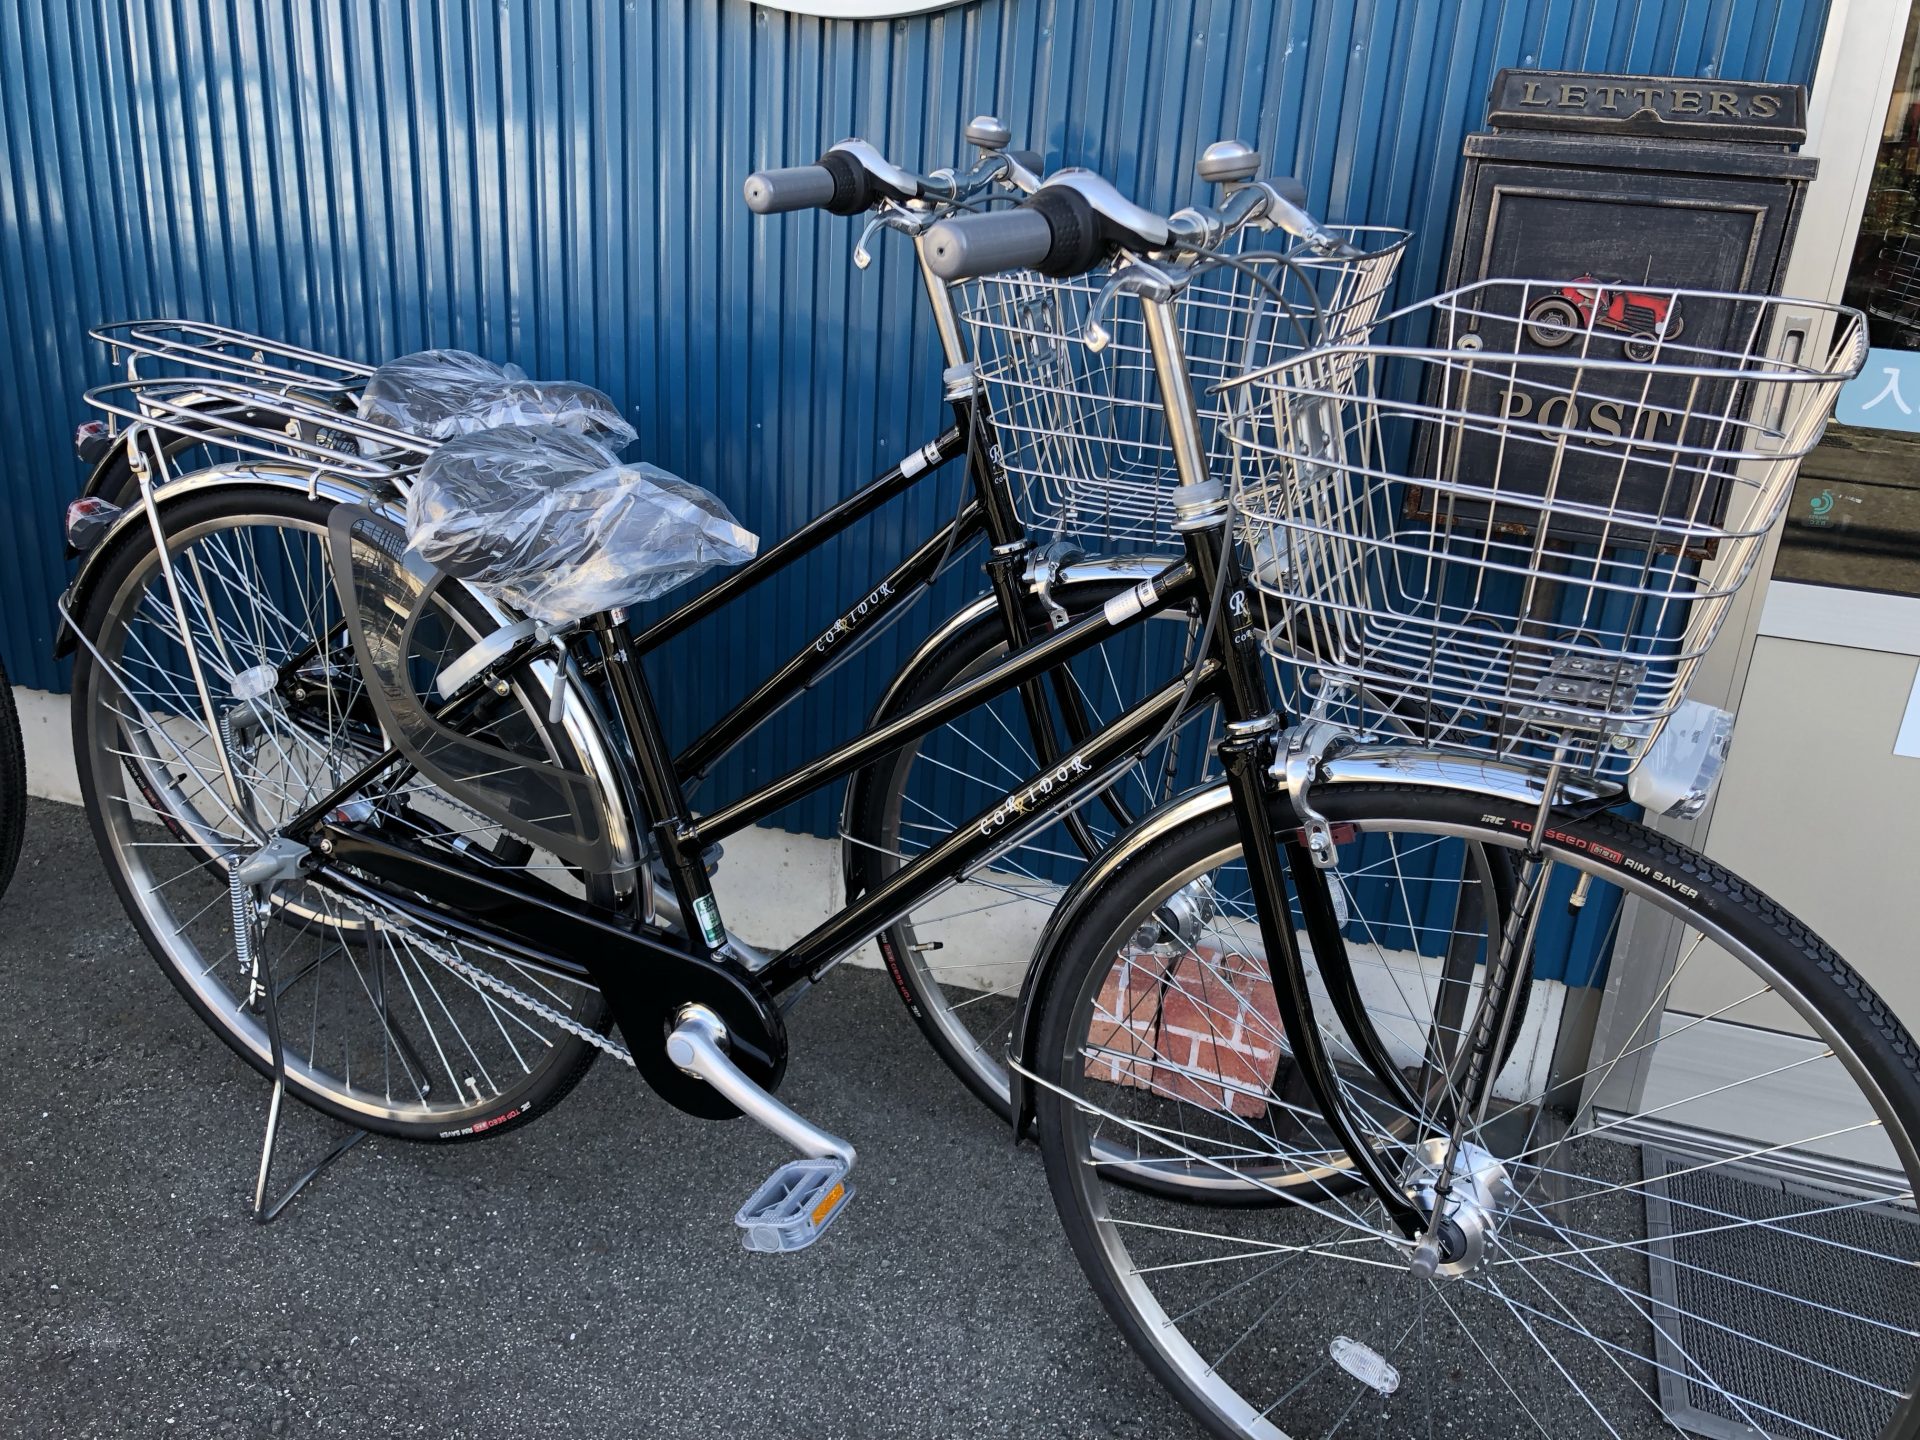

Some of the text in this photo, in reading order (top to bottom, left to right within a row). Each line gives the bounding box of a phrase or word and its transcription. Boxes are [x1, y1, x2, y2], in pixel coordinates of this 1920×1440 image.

[1520, 82, 1782, 118] LETTERS
[1493, 390, 1672, 452] POST
[1861, 367, 1920, 415] 入
[816, 582, 895, 652] CORRIDOR
[980, 756, 1092, 835] CORRIDOR
[1511, 820, 1535, 833] TO
[1545, 829, 1587, 849] SEED
[1624, 858, 1650, 875] RIM
[1652, 871, 1699, 899] SAVER
[507, 1109, 520, 1119] TOP
